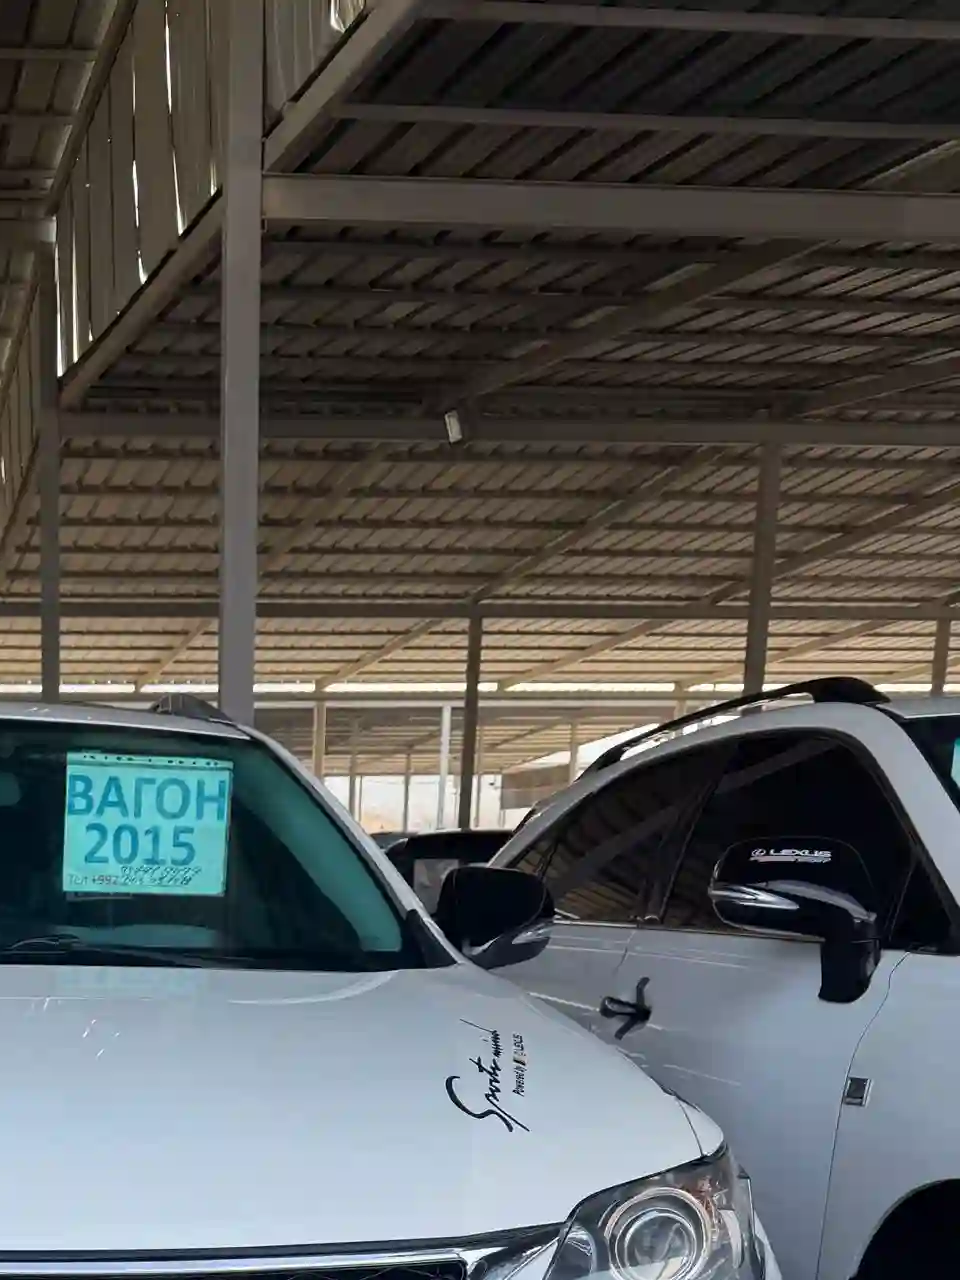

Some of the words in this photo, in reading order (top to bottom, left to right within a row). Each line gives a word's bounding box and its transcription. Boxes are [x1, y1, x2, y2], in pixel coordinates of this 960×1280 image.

[67, 774, 226, 821] ВАГОН
[84, 822, 196, 866] 2015
[769, 848, 832, 858] LEXUS
